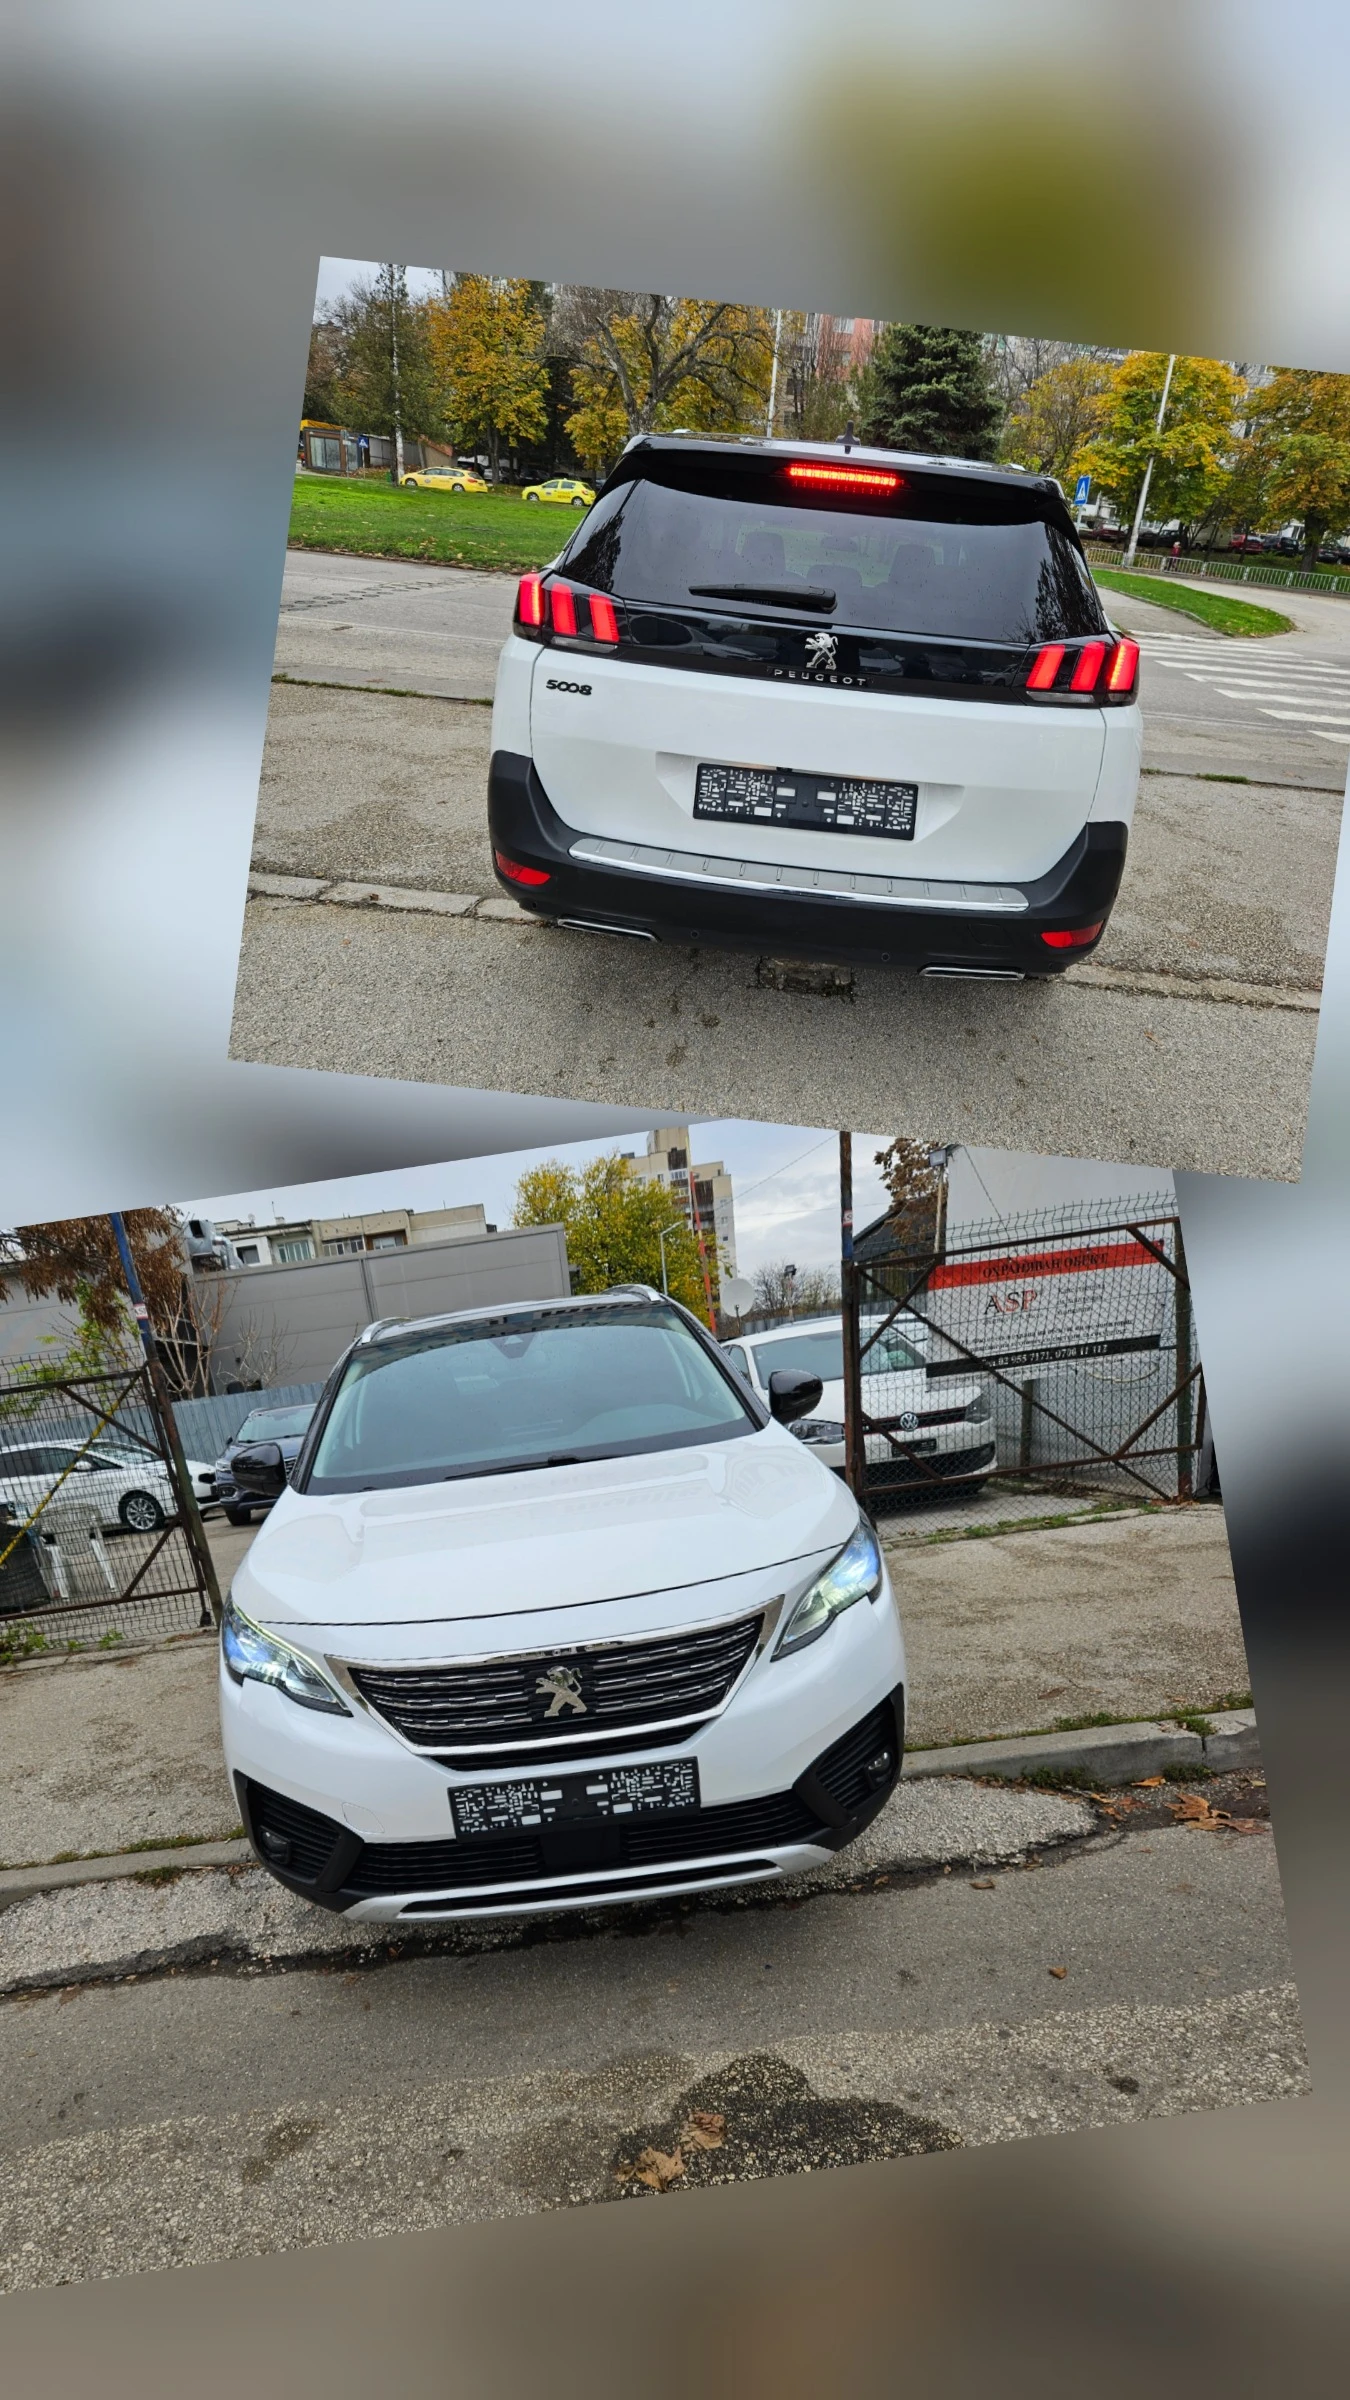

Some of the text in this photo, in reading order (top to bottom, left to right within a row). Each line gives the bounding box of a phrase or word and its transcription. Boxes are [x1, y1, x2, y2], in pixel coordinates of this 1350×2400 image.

[773, 668, 866, 686] PEUGEOT
[545, 679, 593, 696] 5008
[983, 1289, 1038, 1315] ASP
